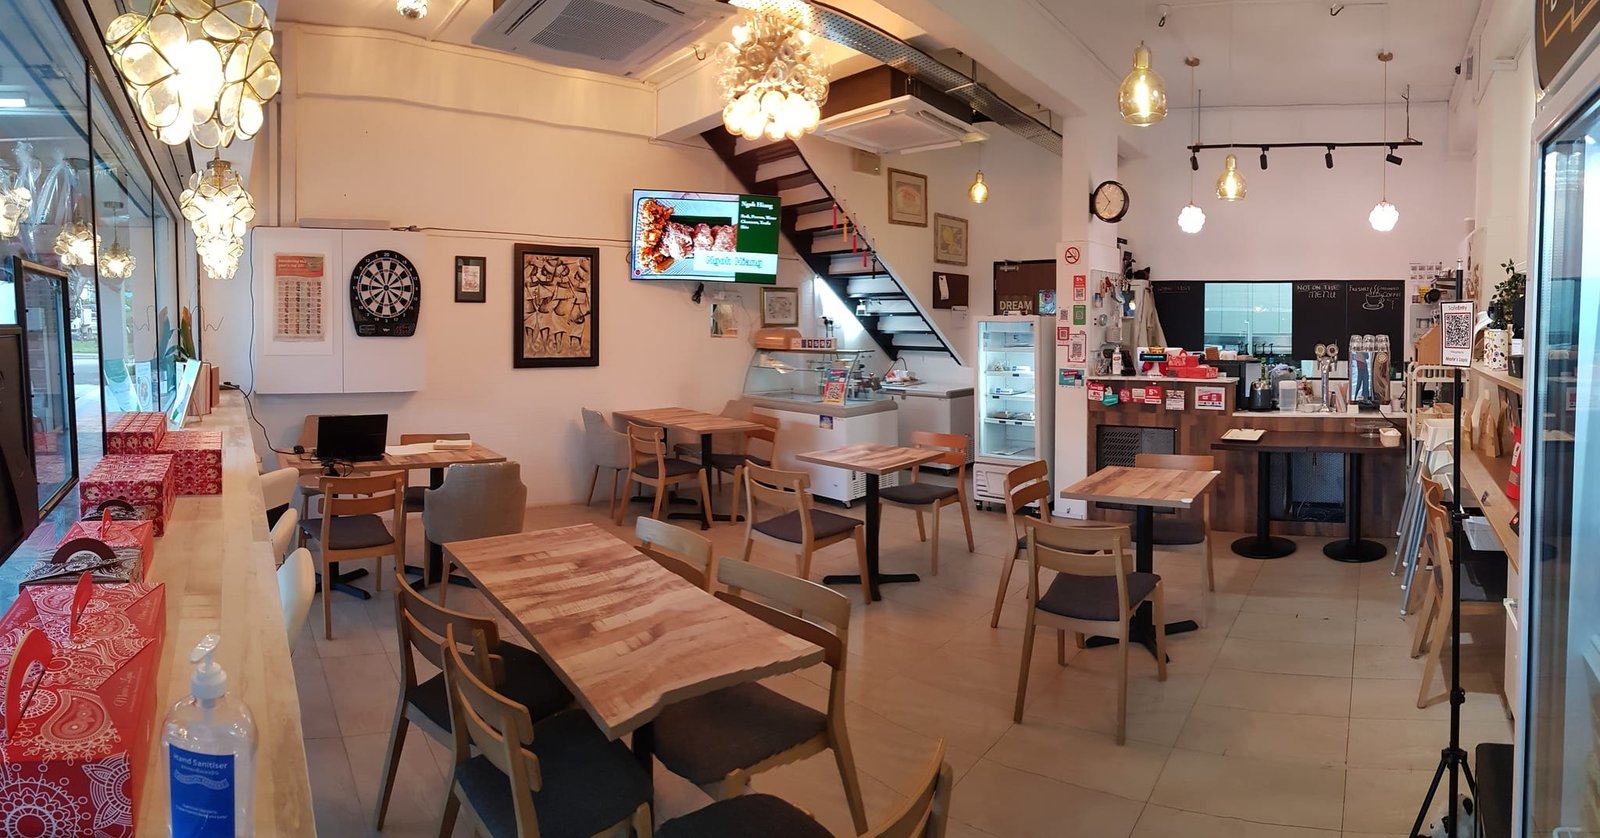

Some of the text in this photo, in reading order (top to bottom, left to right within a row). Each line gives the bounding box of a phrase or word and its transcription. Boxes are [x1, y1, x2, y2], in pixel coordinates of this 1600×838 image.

[1000, 300, 1032, 310] DREAM
[173, 753, 192, 765] Hand
[192, 759, 229, 770] Sanitiser
